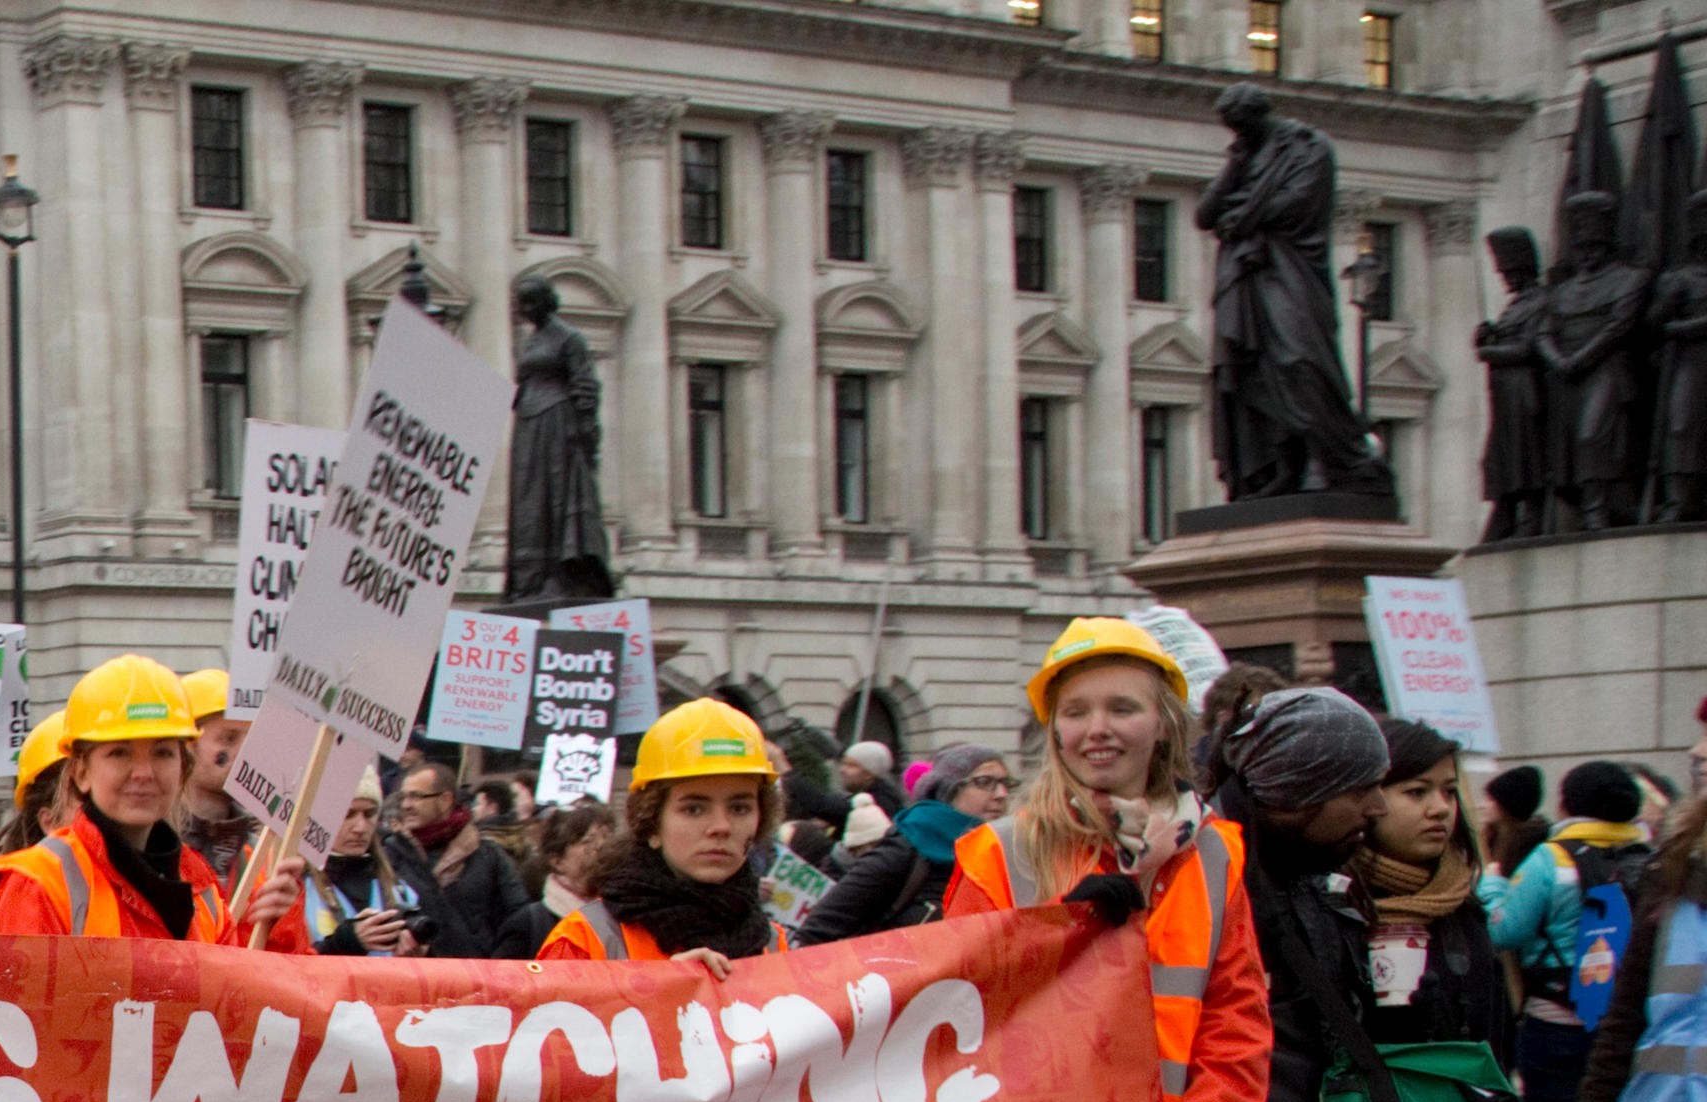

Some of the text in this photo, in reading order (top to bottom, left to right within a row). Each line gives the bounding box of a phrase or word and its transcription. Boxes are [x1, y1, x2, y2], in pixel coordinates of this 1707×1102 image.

[364, 390, 479, 495] RENEWABLE
[267, 452, 338, 497] SOLA
[330, 484, 375, 538] THE
[267, 503, 321, 551] HALT
[342, 546, 416, 617] BRIGHT
[461, 619, 477, 641] 3
[480, 622, 503, 635] OUT
[503, 626, 520, 647] 4
[1383, 610, 1467, 643] 100%
[446, 644, 527, 675] BRITS
[540, 646, 614, 675] Don't
[444, 683, 518, 703] RENEWABLE
[454, 673, 512, 689] SUPPORT
[534, 673, 615, 701] Bomb
[233, 688, 264, 709] DAI
[275, 655, 406, 743] DAILY SUCCESS
[455, 697, 505, 713] ENERGY
[536, 701, 608, 731] Syria
[235, 760, 331, 854] DAILY SESS
